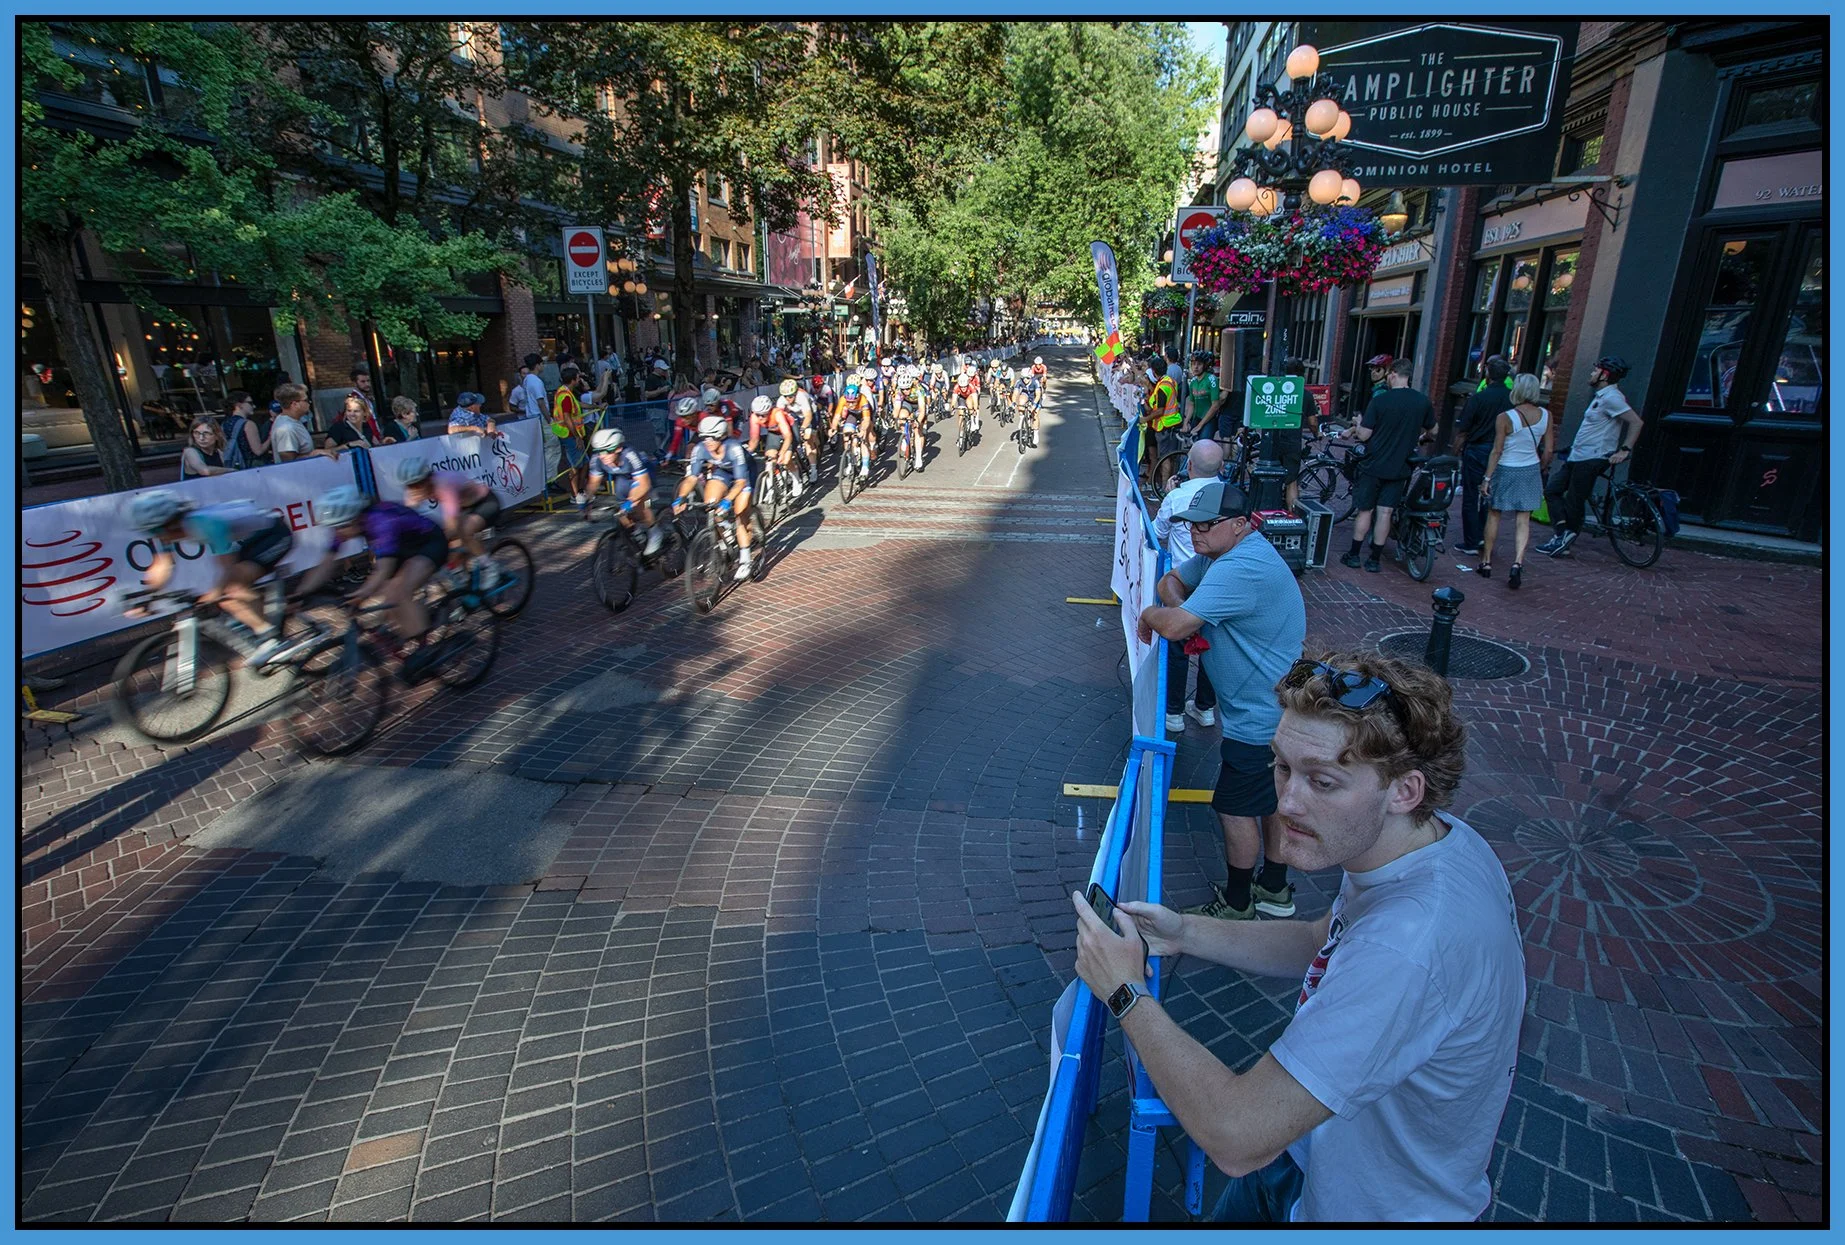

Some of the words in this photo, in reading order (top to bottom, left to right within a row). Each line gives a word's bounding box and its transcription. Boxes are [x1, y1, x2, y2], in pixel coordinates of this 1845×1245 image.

[1421, 52, 1444, 66] THE
[1343, 65, 1536, 101] AMPLIGHTER
[1369, 106, 1424, 121] PUBLIC
[1431, 102, 1481, 118] HOUSE
[1399, 130, 1417, 139] est.
[1419, 128, 1443, 139] 1899
[1352, 164, 1429, 178] OMINION
[1438, 161, 1493, 174] HOTEL
[1755, 189, 1772, 200] 92
[571, 279, 604, 287] BICYCLES
[1255, 395, 1272, 405] CAR
[1274, 394, 1299, 405] LIGHT
[1264, 404, 1287, 415] ZONE
